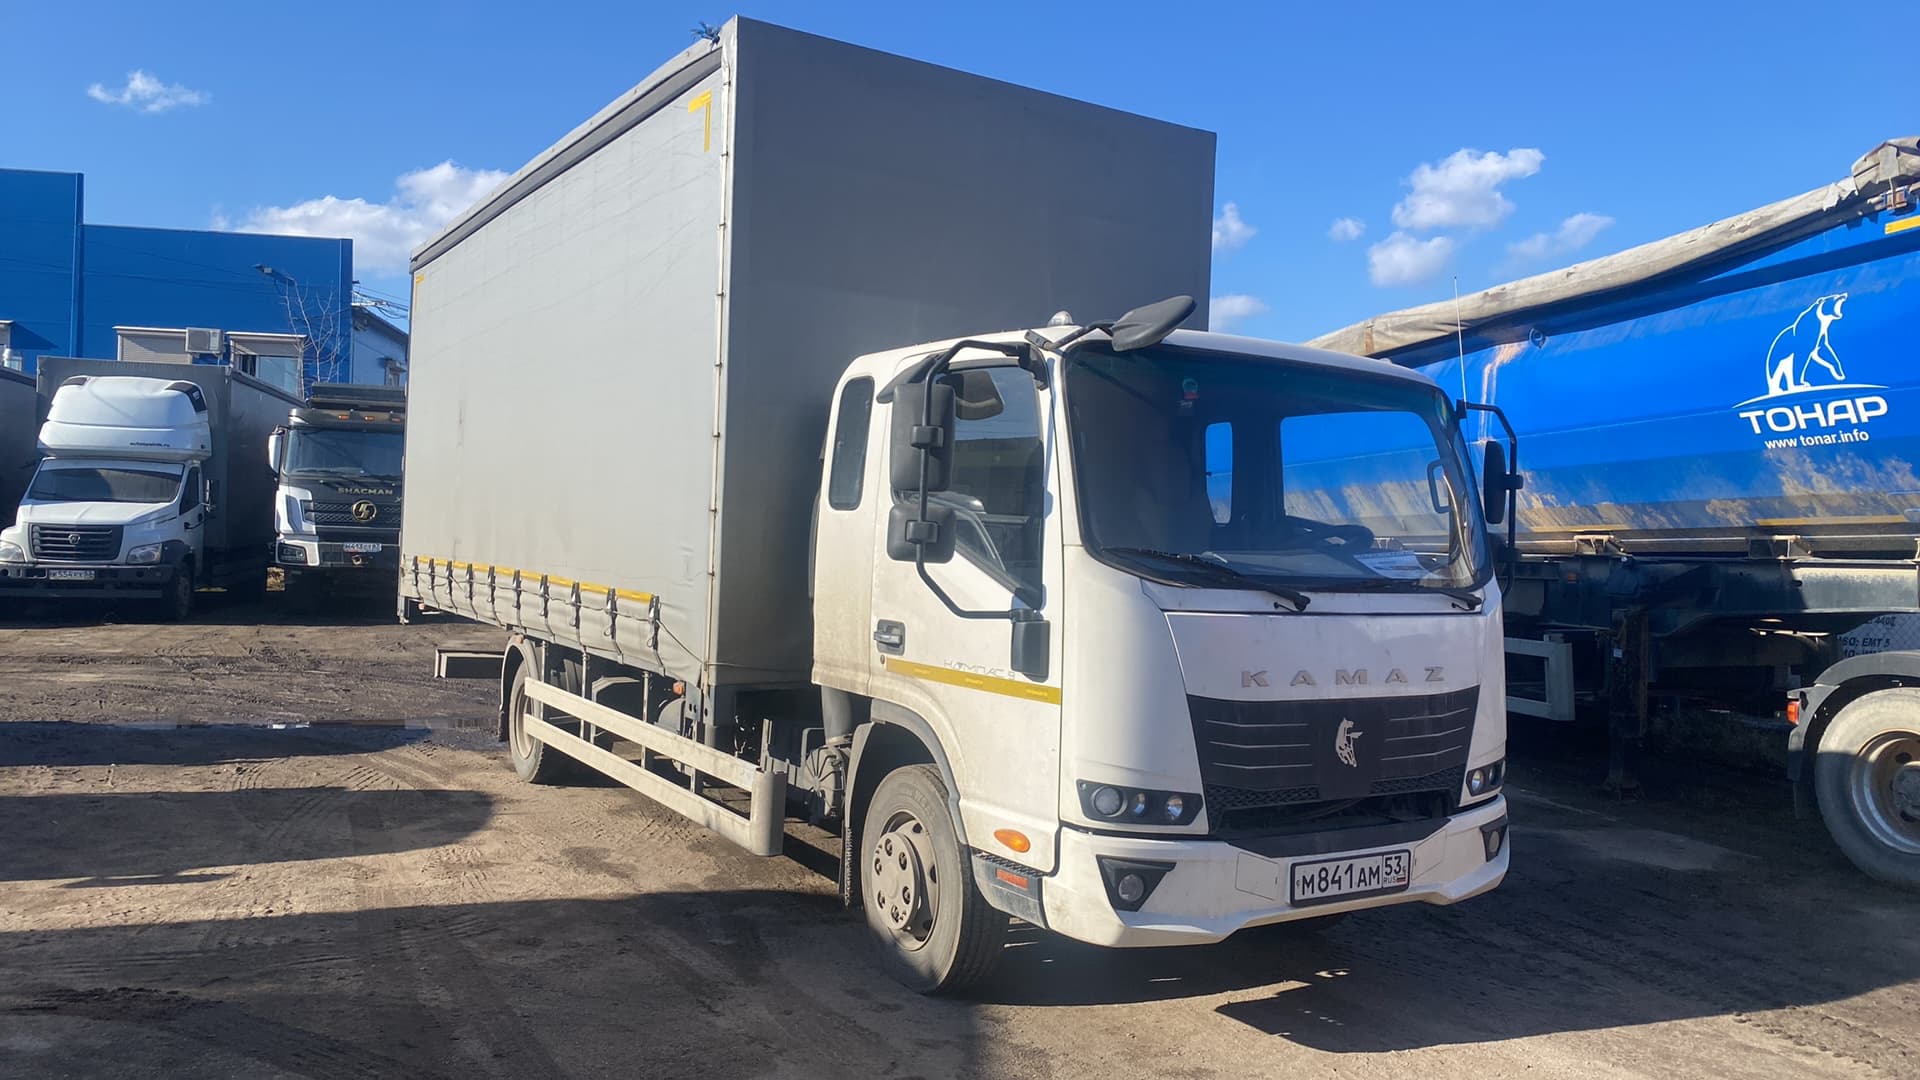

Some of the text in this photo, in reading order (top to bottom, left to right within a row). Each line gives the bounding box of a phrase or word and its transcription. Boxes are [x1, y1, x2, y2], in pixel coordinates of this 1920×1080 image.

[1739, 396, 1888, 434] ТОНАР
[338, 487, 393, 495] SHACMAN
[1241, 666, 1445, 688] KAMAZ
